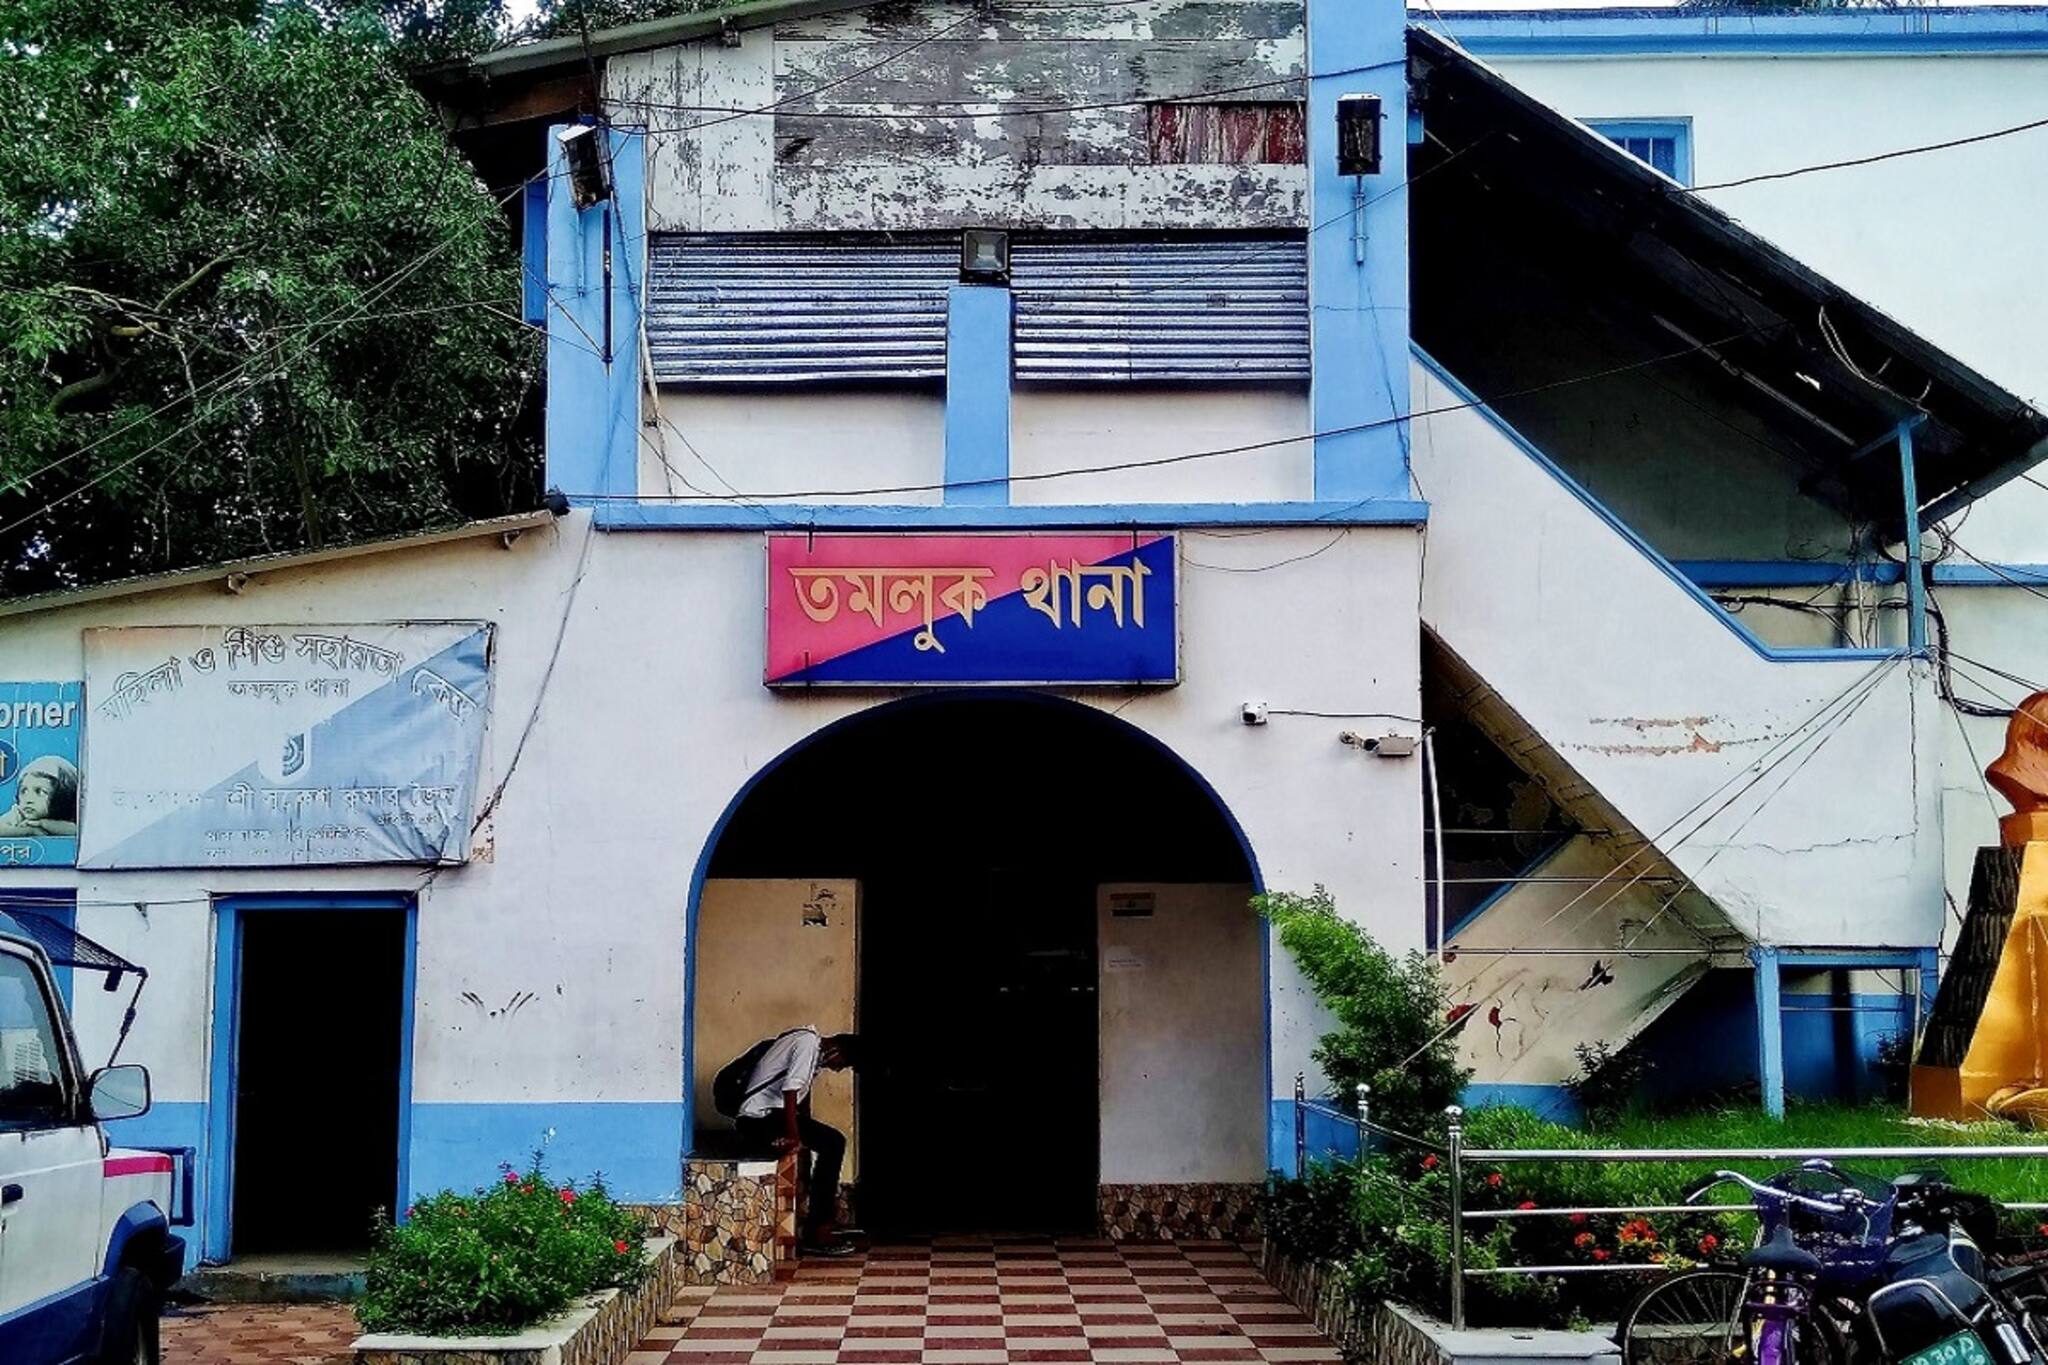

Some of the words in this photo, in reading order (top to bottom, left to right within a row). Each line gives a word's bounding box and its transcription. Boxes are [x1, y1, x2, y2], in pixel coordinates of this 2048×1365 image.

[787, 566, 996, 654] তমলুক
[1020, 557, 1152, 629] থানা
[187, 646, 217, 675] ও
[221, 626, 287, 672] শিশু
